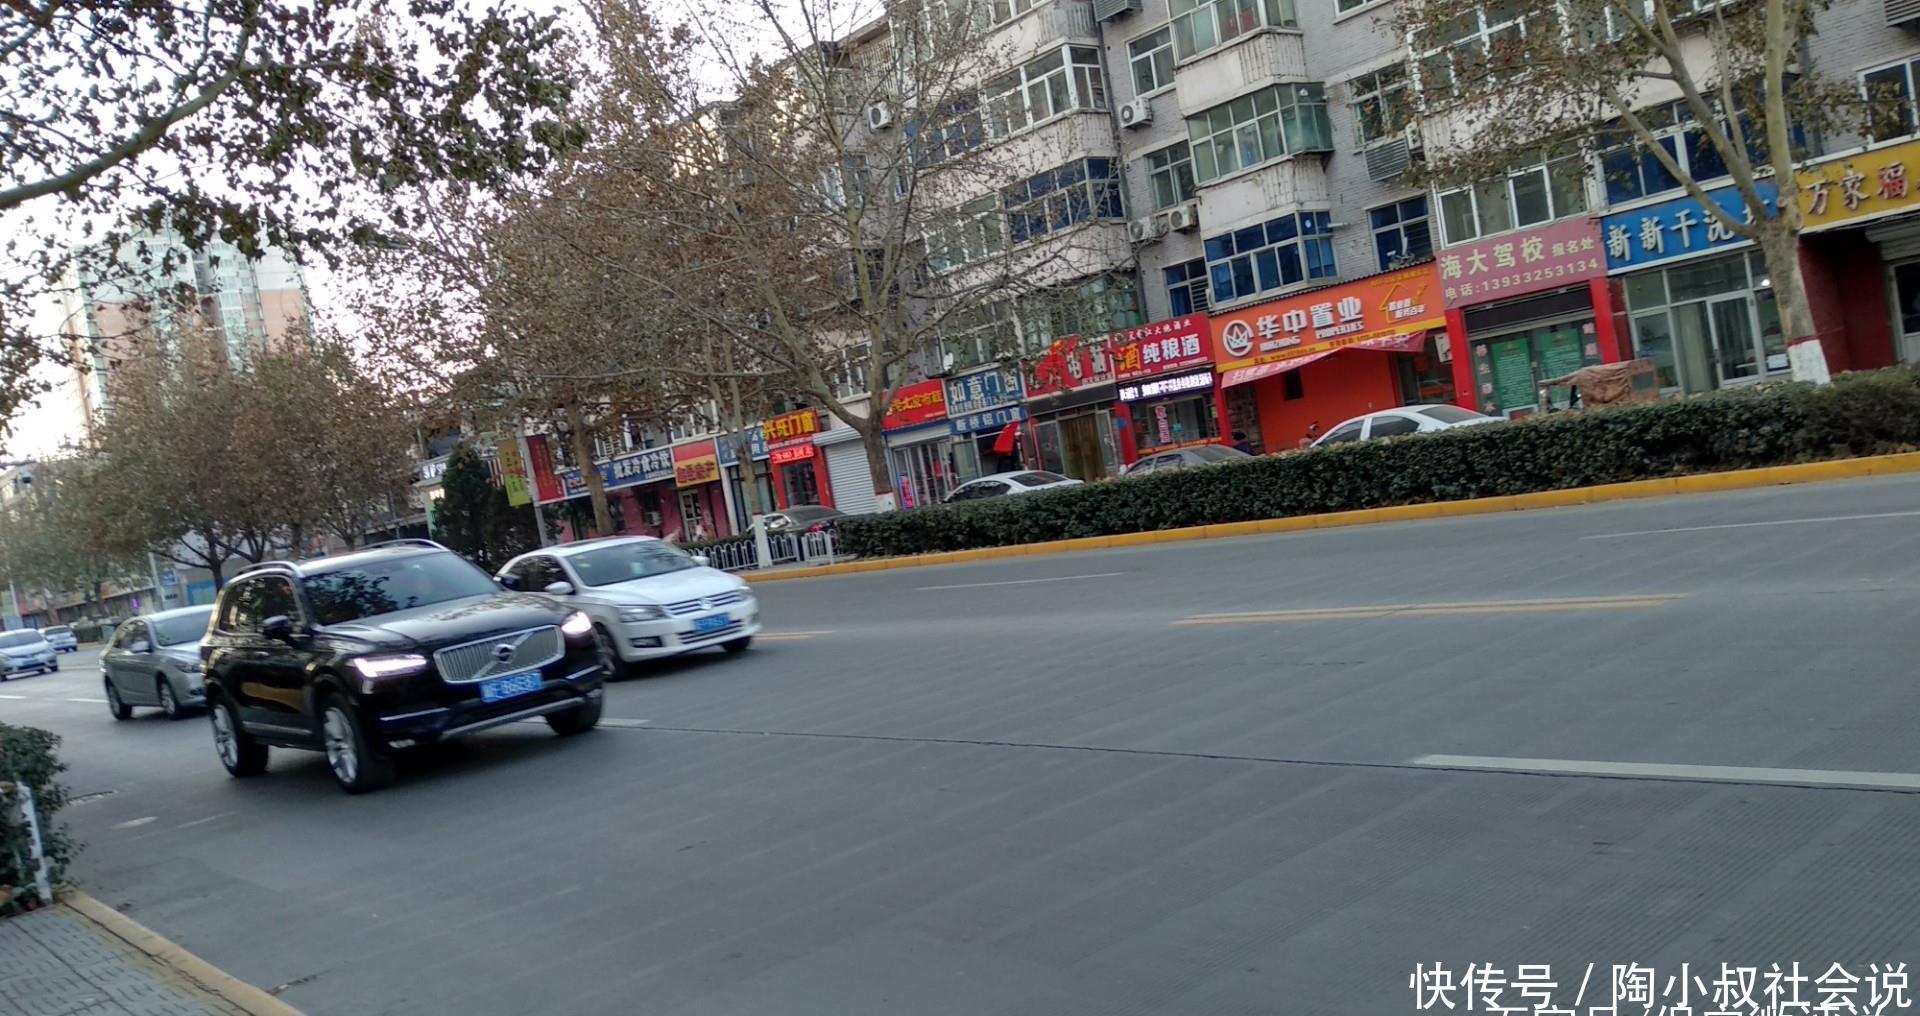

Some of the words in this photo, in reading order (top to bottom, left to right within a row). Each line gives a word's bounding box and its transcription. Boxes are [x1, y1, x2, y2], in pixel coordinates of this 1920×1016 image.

[1806, 161, 1920, 215] 万家福
[1607, 199, 1771, 261] 新新干洗
[1441, 236, 1544, 280] 海大驾校
[1552, 236, 1595, 258] 报名处
[1256, 296, 1364, 339] 华中置业
[763, 411, 815, 441] 兴旺门窗
